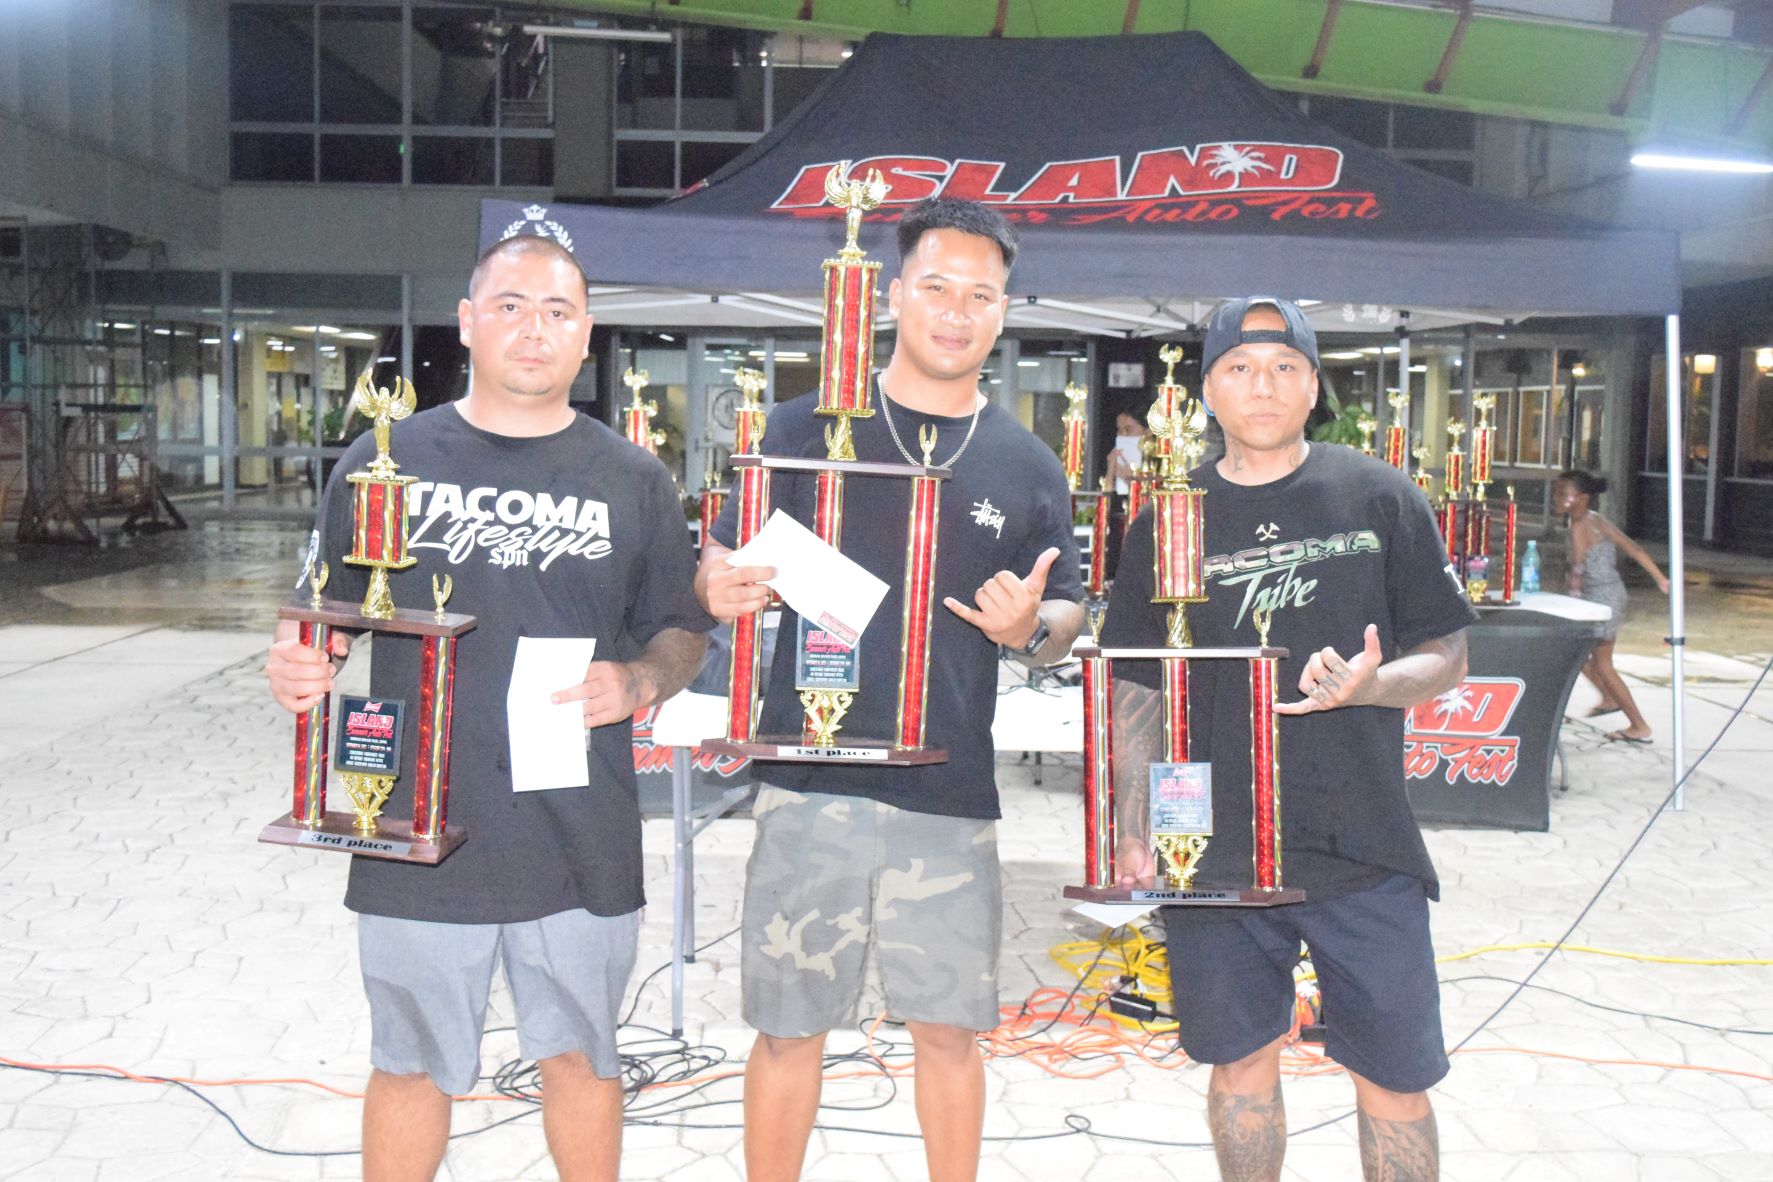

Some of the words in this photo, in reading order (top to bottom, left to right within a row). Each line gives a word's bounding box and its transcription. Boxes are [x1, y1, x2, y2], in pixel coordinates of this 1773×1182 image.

[770, 142, 1344, 208] ISLAND
[1063, 199, 1240, 225] Auto
[1241, 192, 1381, 222] Fest
[407, 482, 611, 539] TACOMA
[407, 510, 614, 573] Lifestyle
[1204, 530, 1382, 579] ACOMA
[1218, 562, 1318, 630] Tribe
[346, 711, 394, 729] ISLAND
[826, 749, 872, 757] place
[1403, 741, 1440, 780] to
[1439, 736, 1520, 787] Fest
[311, 833, 343, 845] 3rd
[346, 839, 393, 851] place
[1144, 891, 1176, 899] 2nd
[1182, 891, 1226, 900] place
